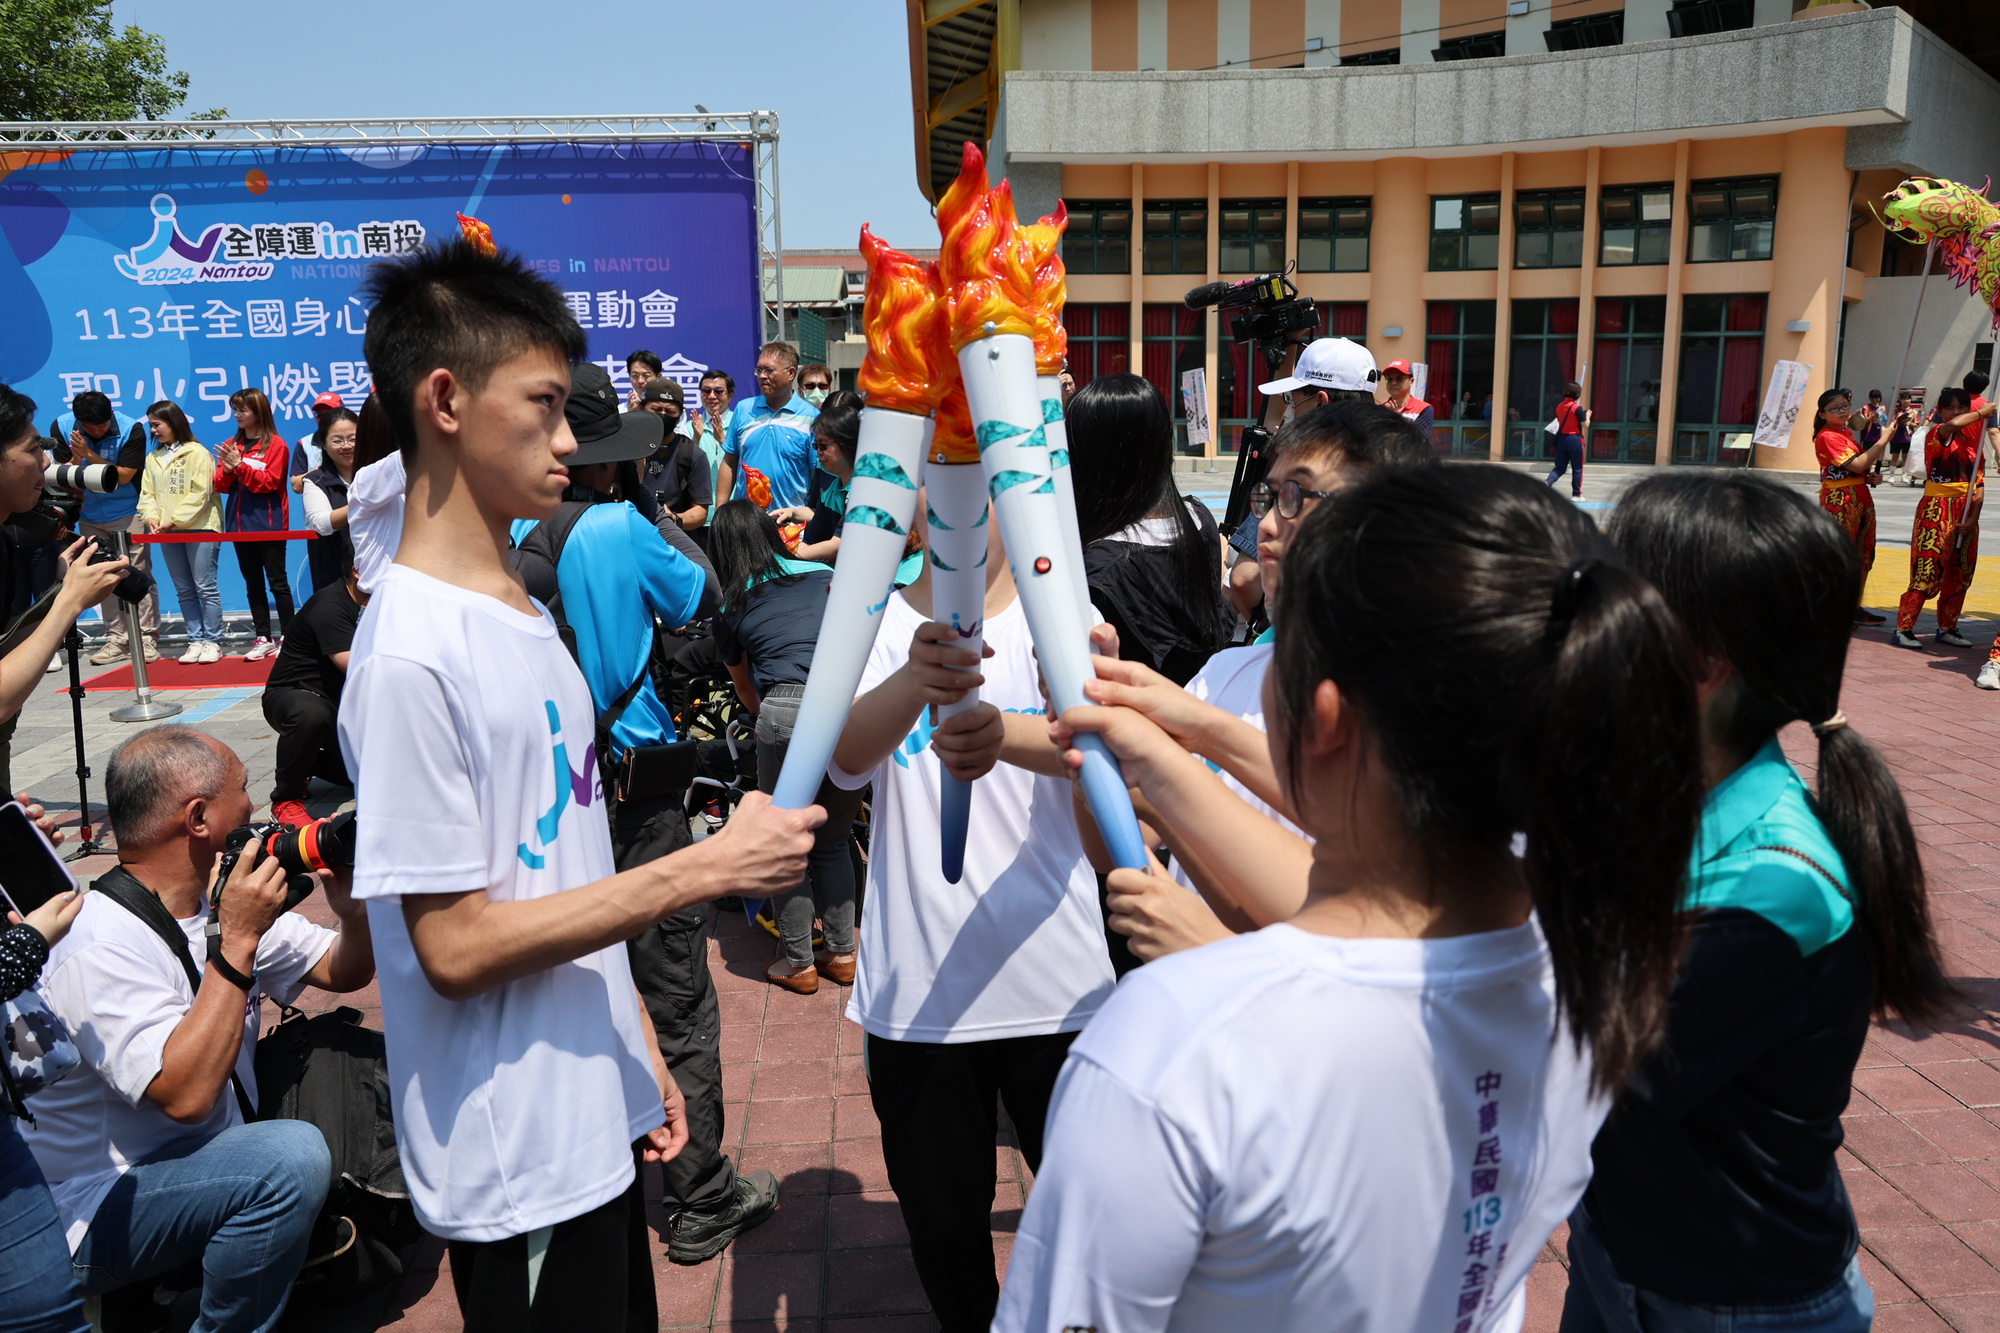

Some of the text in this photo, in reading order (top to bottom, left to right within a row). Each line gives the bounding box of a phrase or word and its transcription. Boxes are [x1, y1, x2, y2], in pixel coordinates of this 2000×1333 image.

[224, 223, 423, 258] 全障運in南投
[142, 264, 271, 282] 2024 Nantou
[569, 258, 586, 273] in
[594, 257, 671, 272] NANTOU
[1914, 498, 1942, 582] 南投縣
